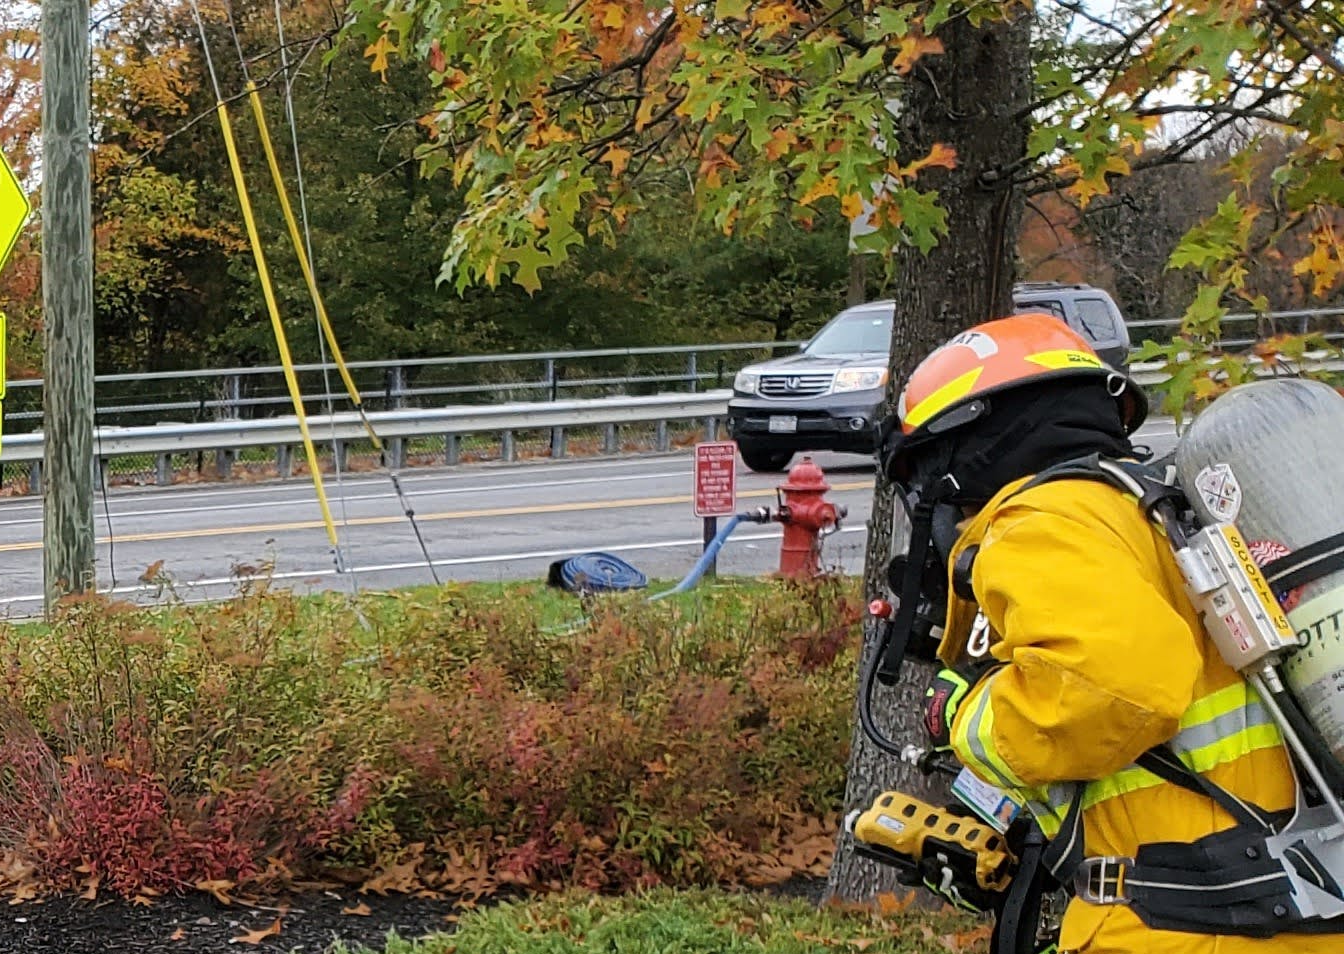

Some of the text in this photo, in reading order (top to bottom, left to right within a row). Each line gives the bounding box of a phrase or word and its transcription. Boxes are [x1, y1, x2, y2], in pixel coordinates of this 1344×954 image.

[952, 333, 981, 345] AT
[1230, 536, 1271, 604] SCOTT
[1296, 608, 1344, 650] OTT
